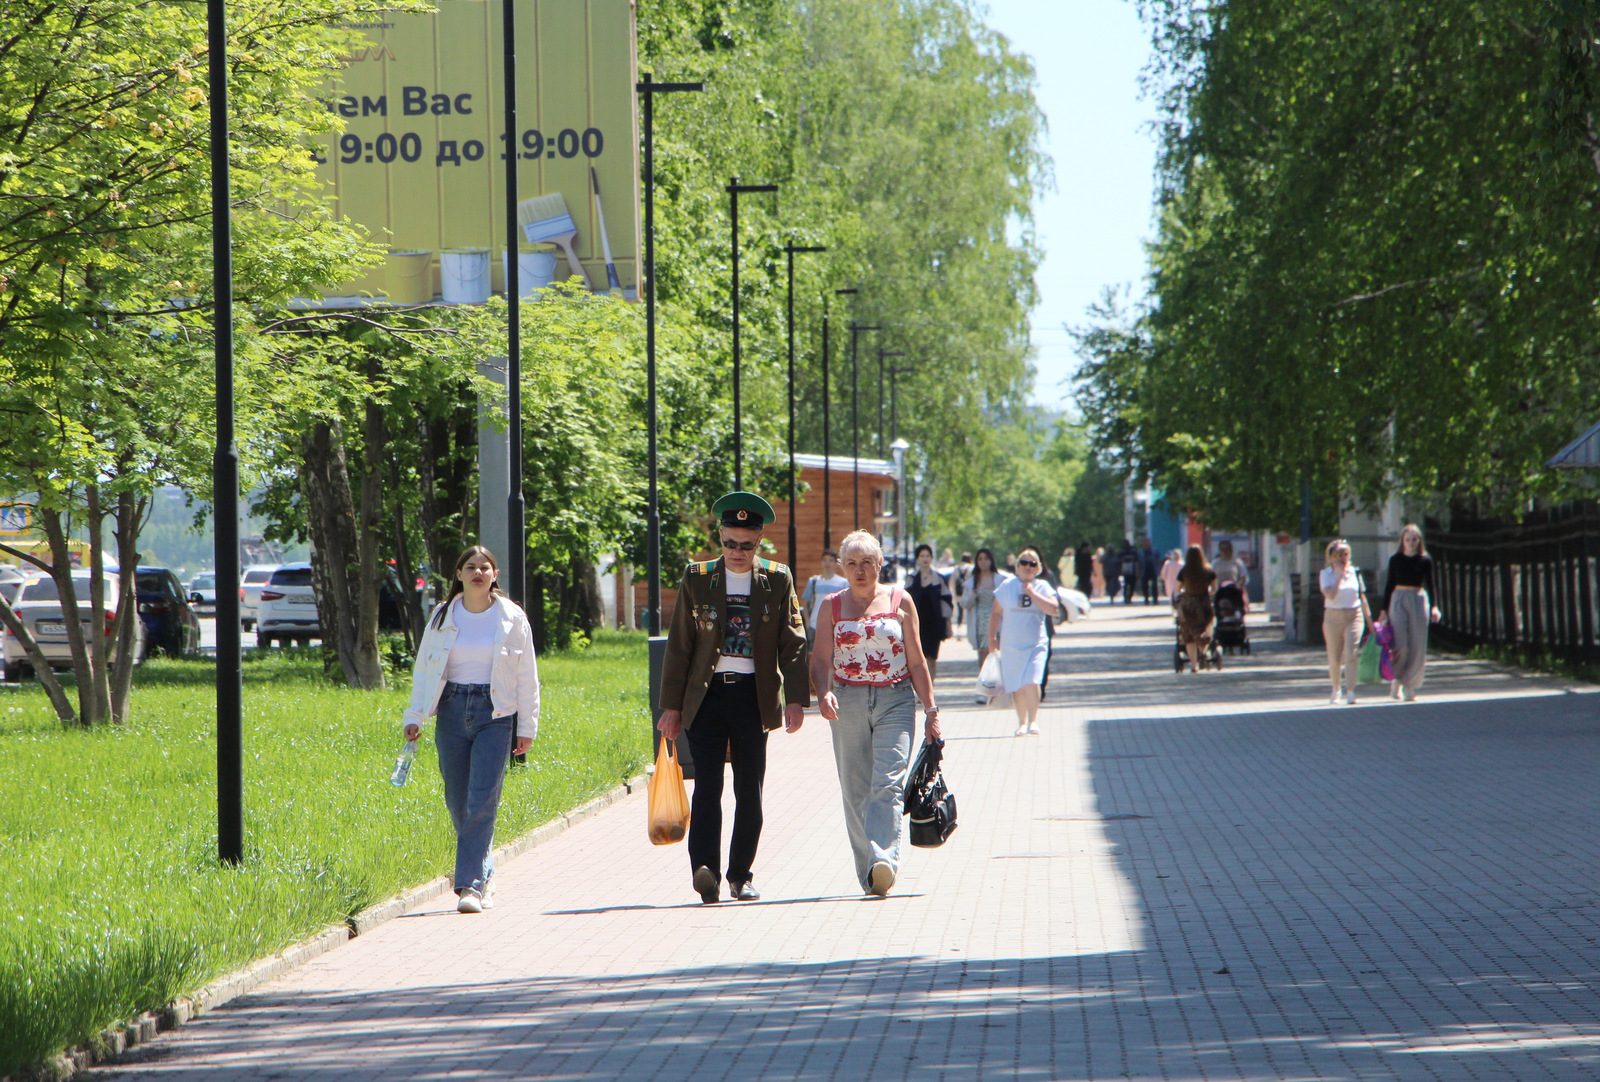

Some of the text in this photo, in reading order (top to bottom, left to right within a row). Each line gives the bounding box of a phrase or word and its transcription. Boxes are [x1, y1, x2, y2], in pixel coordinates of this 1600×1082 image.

[403, 86, 473, 116] Вас
[340, 132, 422, 164] 9:00
[436, 139, 485, 167] до
